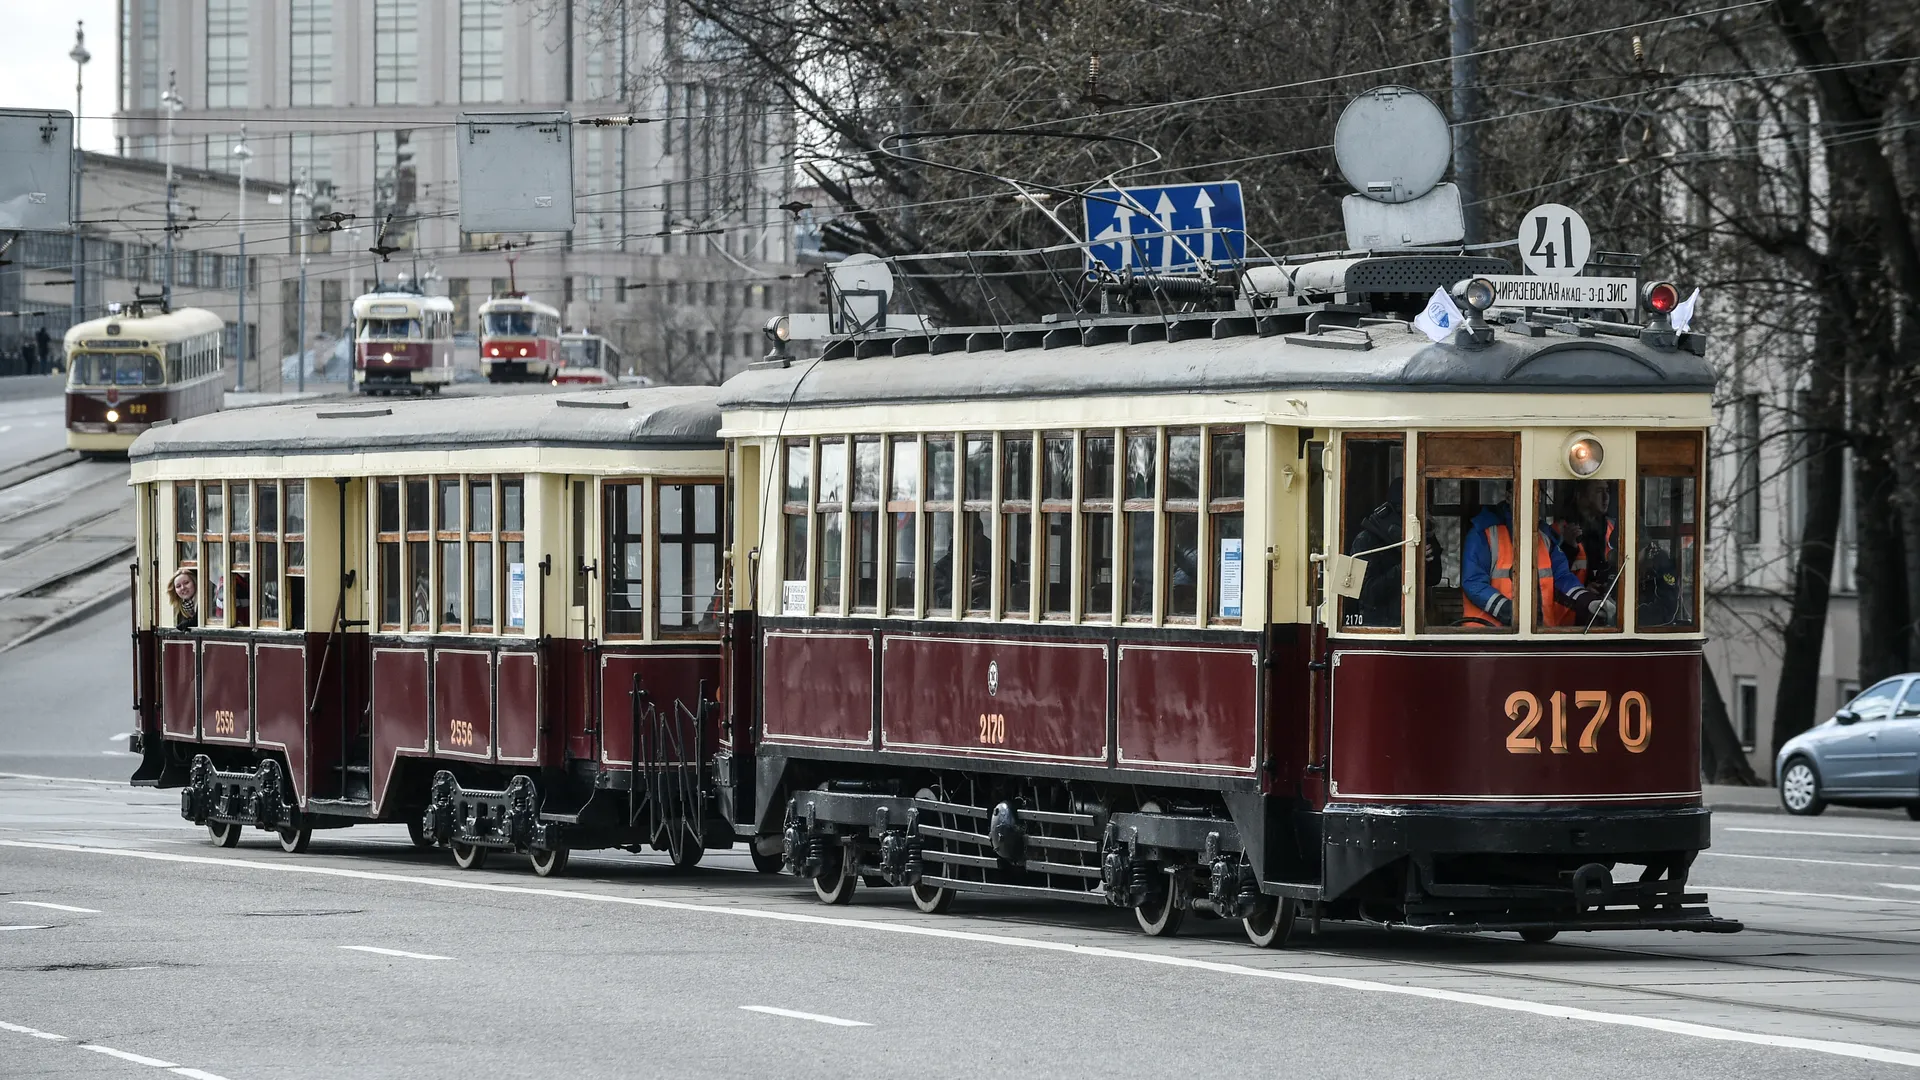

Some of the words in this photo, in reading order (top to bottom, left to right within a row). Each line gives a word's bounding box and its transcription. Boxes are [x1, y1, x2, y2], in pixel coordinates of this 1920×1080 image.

[1530, 216, 1575, 268] 41
[1606, 283, 1628, 302] ЗИС
[1345, 614, 1363, 625] 2170
[215, 710, 234, 734] 2556
[450, 719, 473, 748] 2556
[980, 713, 1005, 744] 2170
[1504, 690, 1652, 754] 2170
